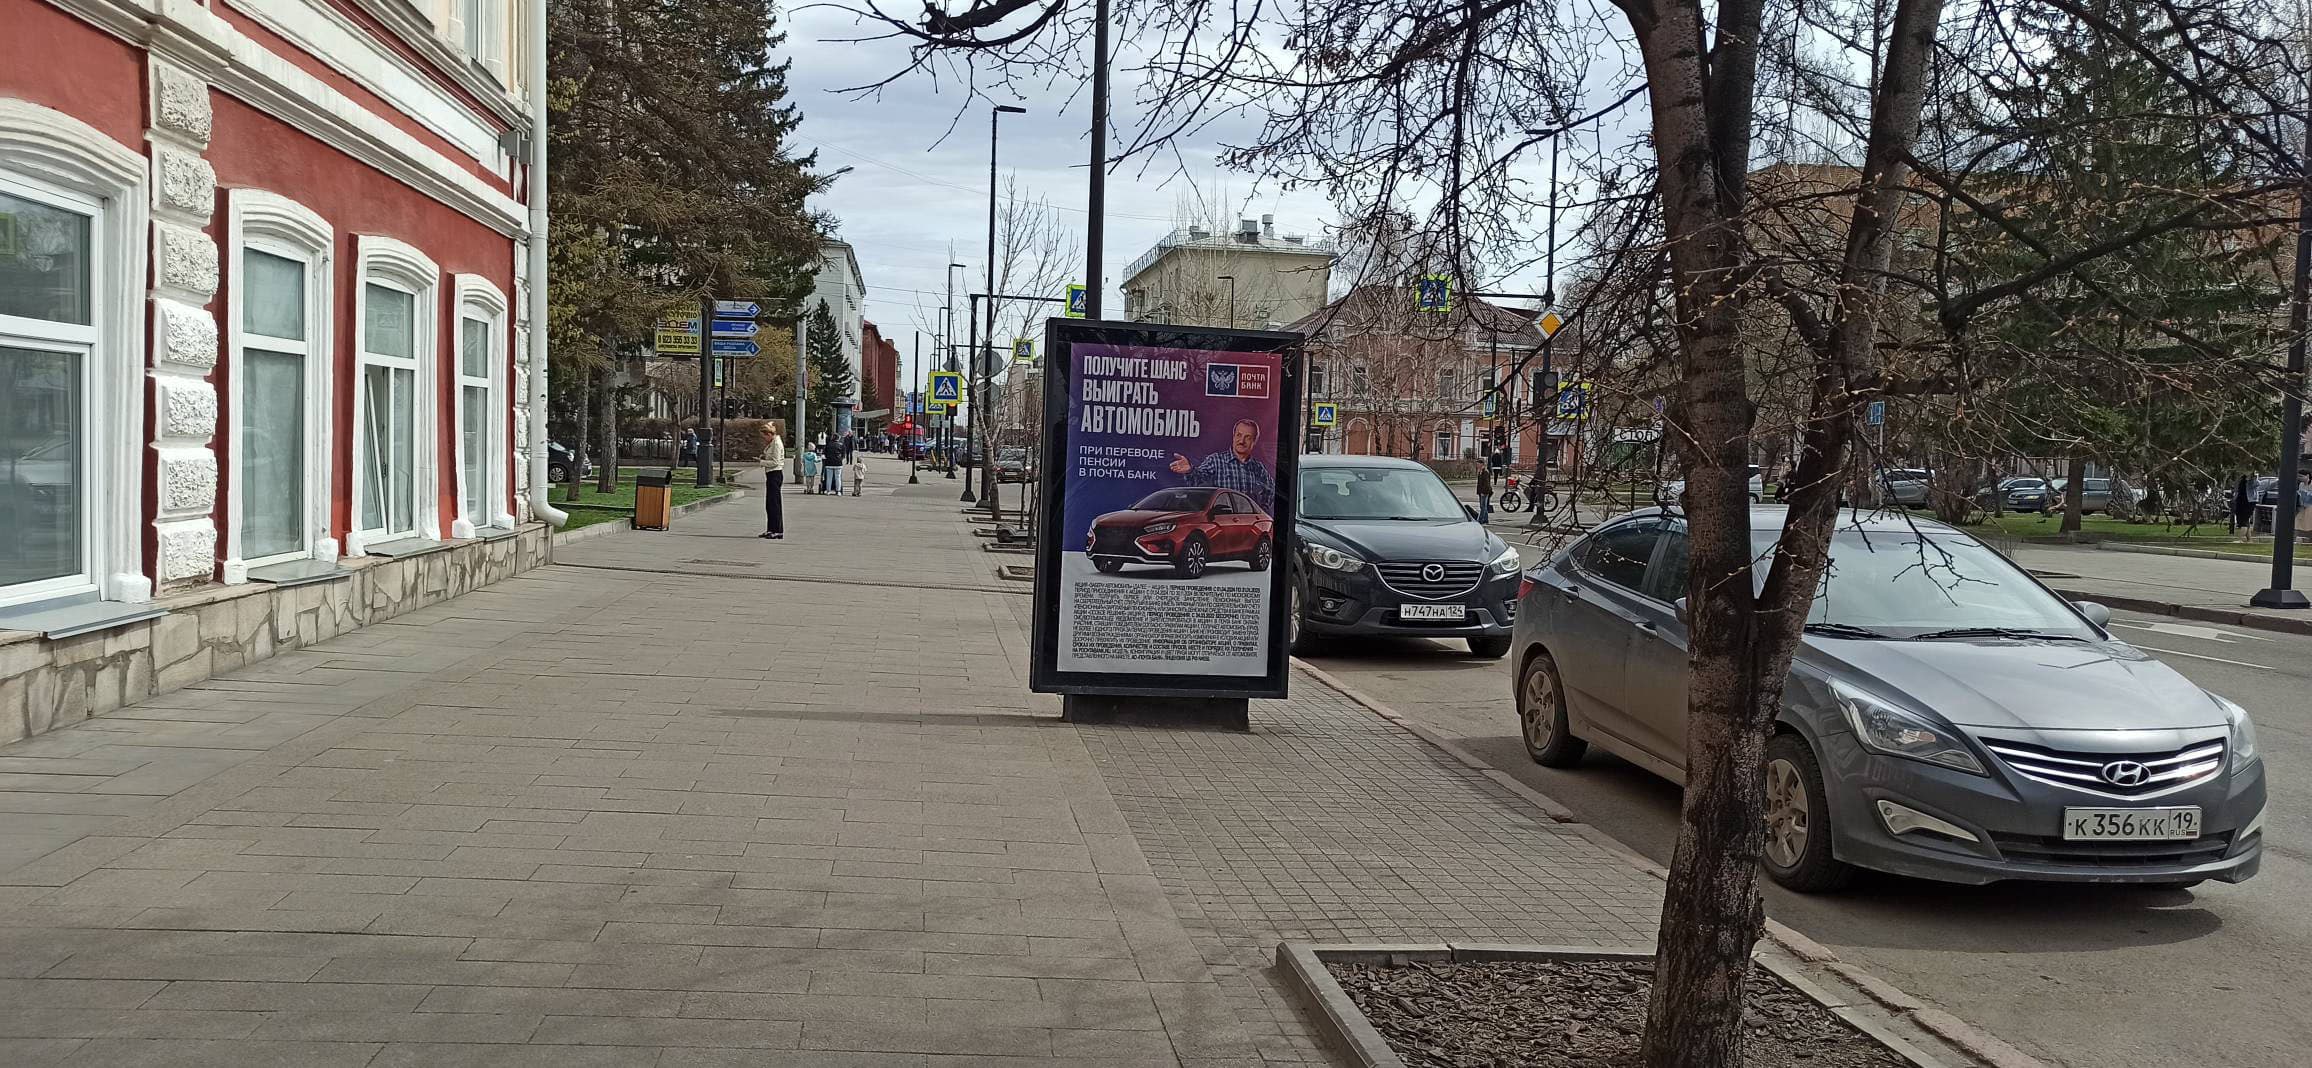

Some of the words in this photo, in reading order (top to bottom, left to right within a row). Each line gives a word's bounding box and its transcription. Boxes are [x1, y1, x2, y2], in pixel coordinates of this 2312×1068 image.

[1083, 355, 1148, 378] ПОЛУЧИТЕ
[1150, 359, 1187, 381] ШАНС
[1241, 373, 1266, 381] ПОЧТА
[1082, 379, 1159, 405] ВЫИГРАТЬ
[1241, 382, 1262, 390] БАНК
[1080, 404, 1200, 438] АВТОМОБИЛЬ
[1079, 445, 1103, 455] ПРИ
[1105, 447, 1165, 459] ПЕРЕВОДЕ
[1079, 456, 1126, 467] ПЕНСИИ
[1079, 468, 1086, 477] В
[1089, 468, 1125, 479] ПОЧТА
[1127, 470, 1157, 480] БАНК
[2173, 812, 2193, 829] 19
